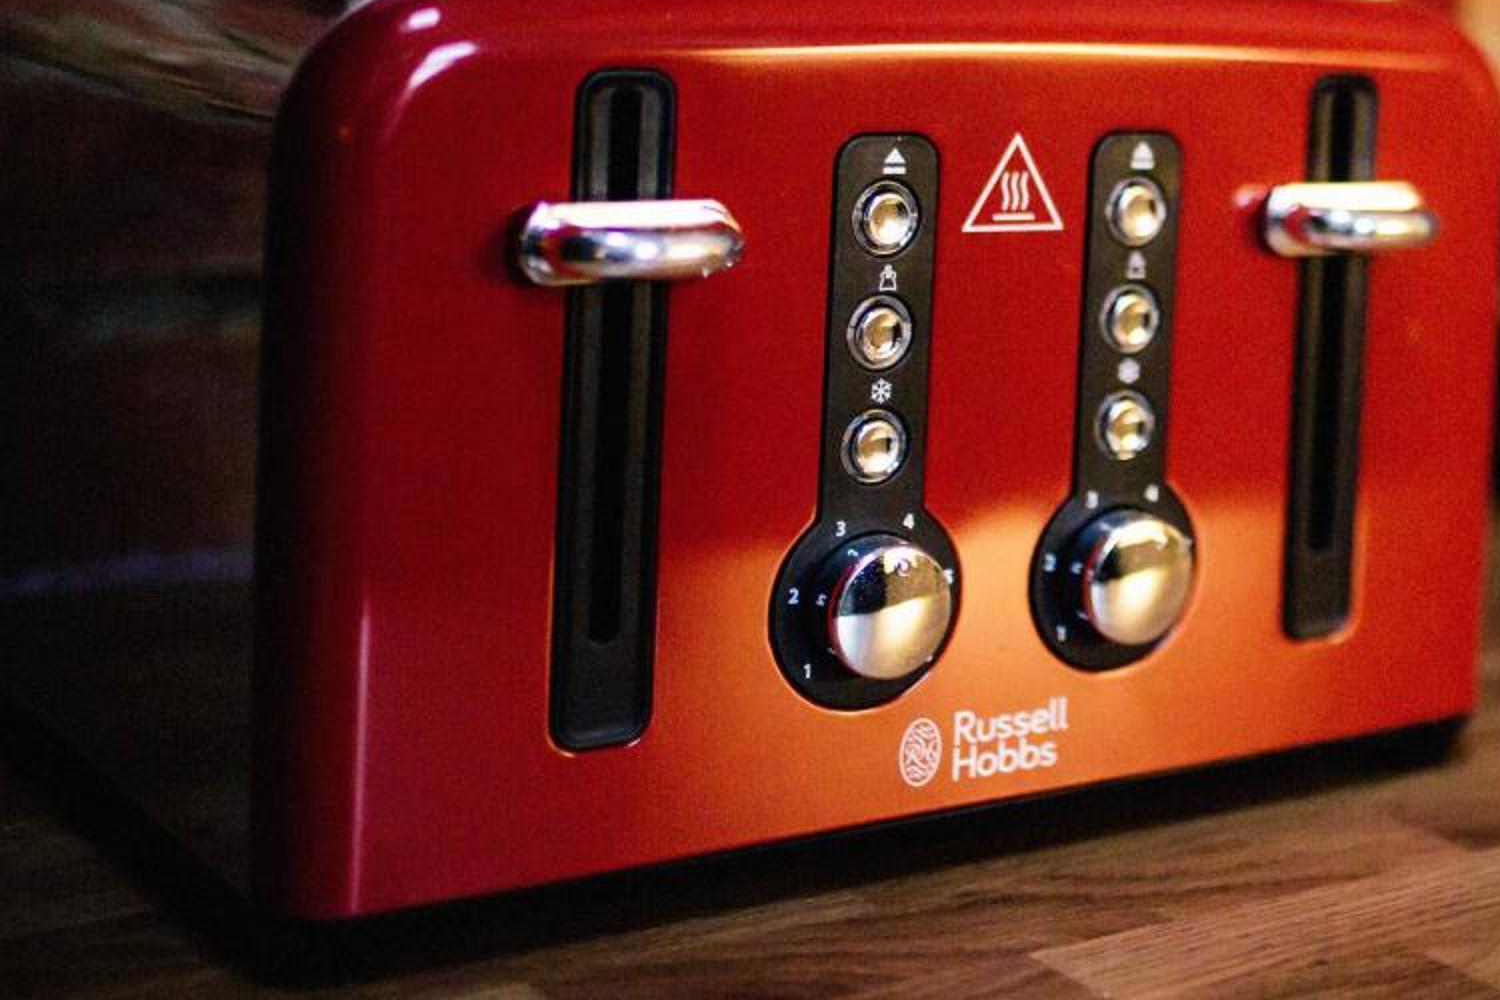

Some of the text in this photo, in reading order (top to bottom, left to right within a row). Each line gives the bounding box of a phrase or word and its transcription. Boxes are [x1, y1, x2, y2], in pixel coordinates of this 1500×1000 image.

[835, 520, 847, 537] 3
[902, 513, 915, 529] 4
[787, 588, 800, 605] 2
[803, 663, 812, 679] 1
[953, 696, 1069, 747] Russell
[951, 735, 1058, 783] Hobbs
